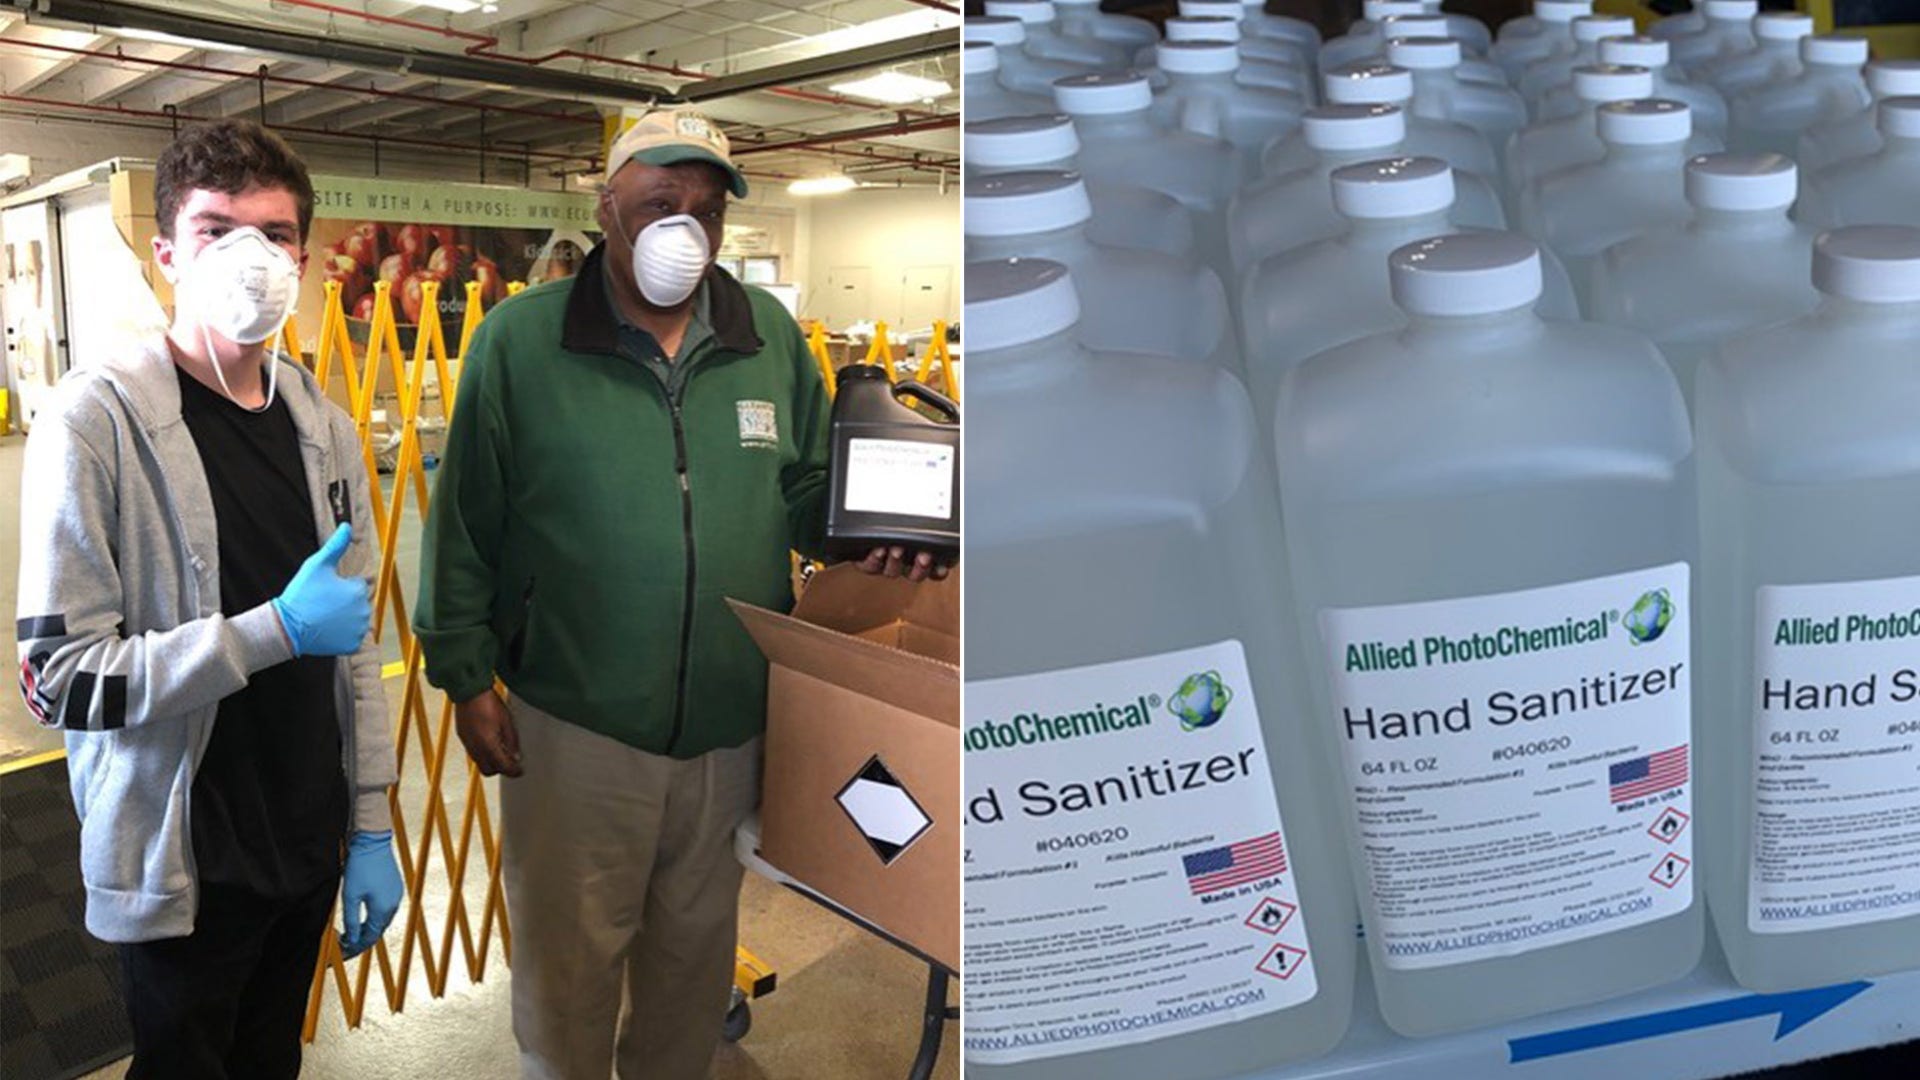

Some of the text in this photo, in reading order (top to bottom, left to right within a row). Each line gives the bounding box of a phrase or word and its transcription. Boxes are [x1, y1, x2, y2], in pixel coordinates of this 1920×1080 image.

[367, 194, 411, 211] WITH
[423, 198, 431, 211] A
[444, 200, 517, 217] PURPOSE:
[1775, 617, 1840, 646] Allied
[1345, 638, 1417, 672] Allied
[1344, 662, 1683, 741] Hand Sanitizer
[1763, 673, 1877, 711] Hand
[1770, 730, 1793, 744] 64
[1797, 730, 1815, 744] FL
[1818, 728, 1841, 743] OZ
[1362, 737, 1571, 776] 64 FL OZ #040620
[1018, 747, 1255, 817] Sanitizer
[1617, 799, 1645, 813] Made
[1035, 826, 1129, 854] #040620
[1201, 876, 1283, 905] Made in USA
